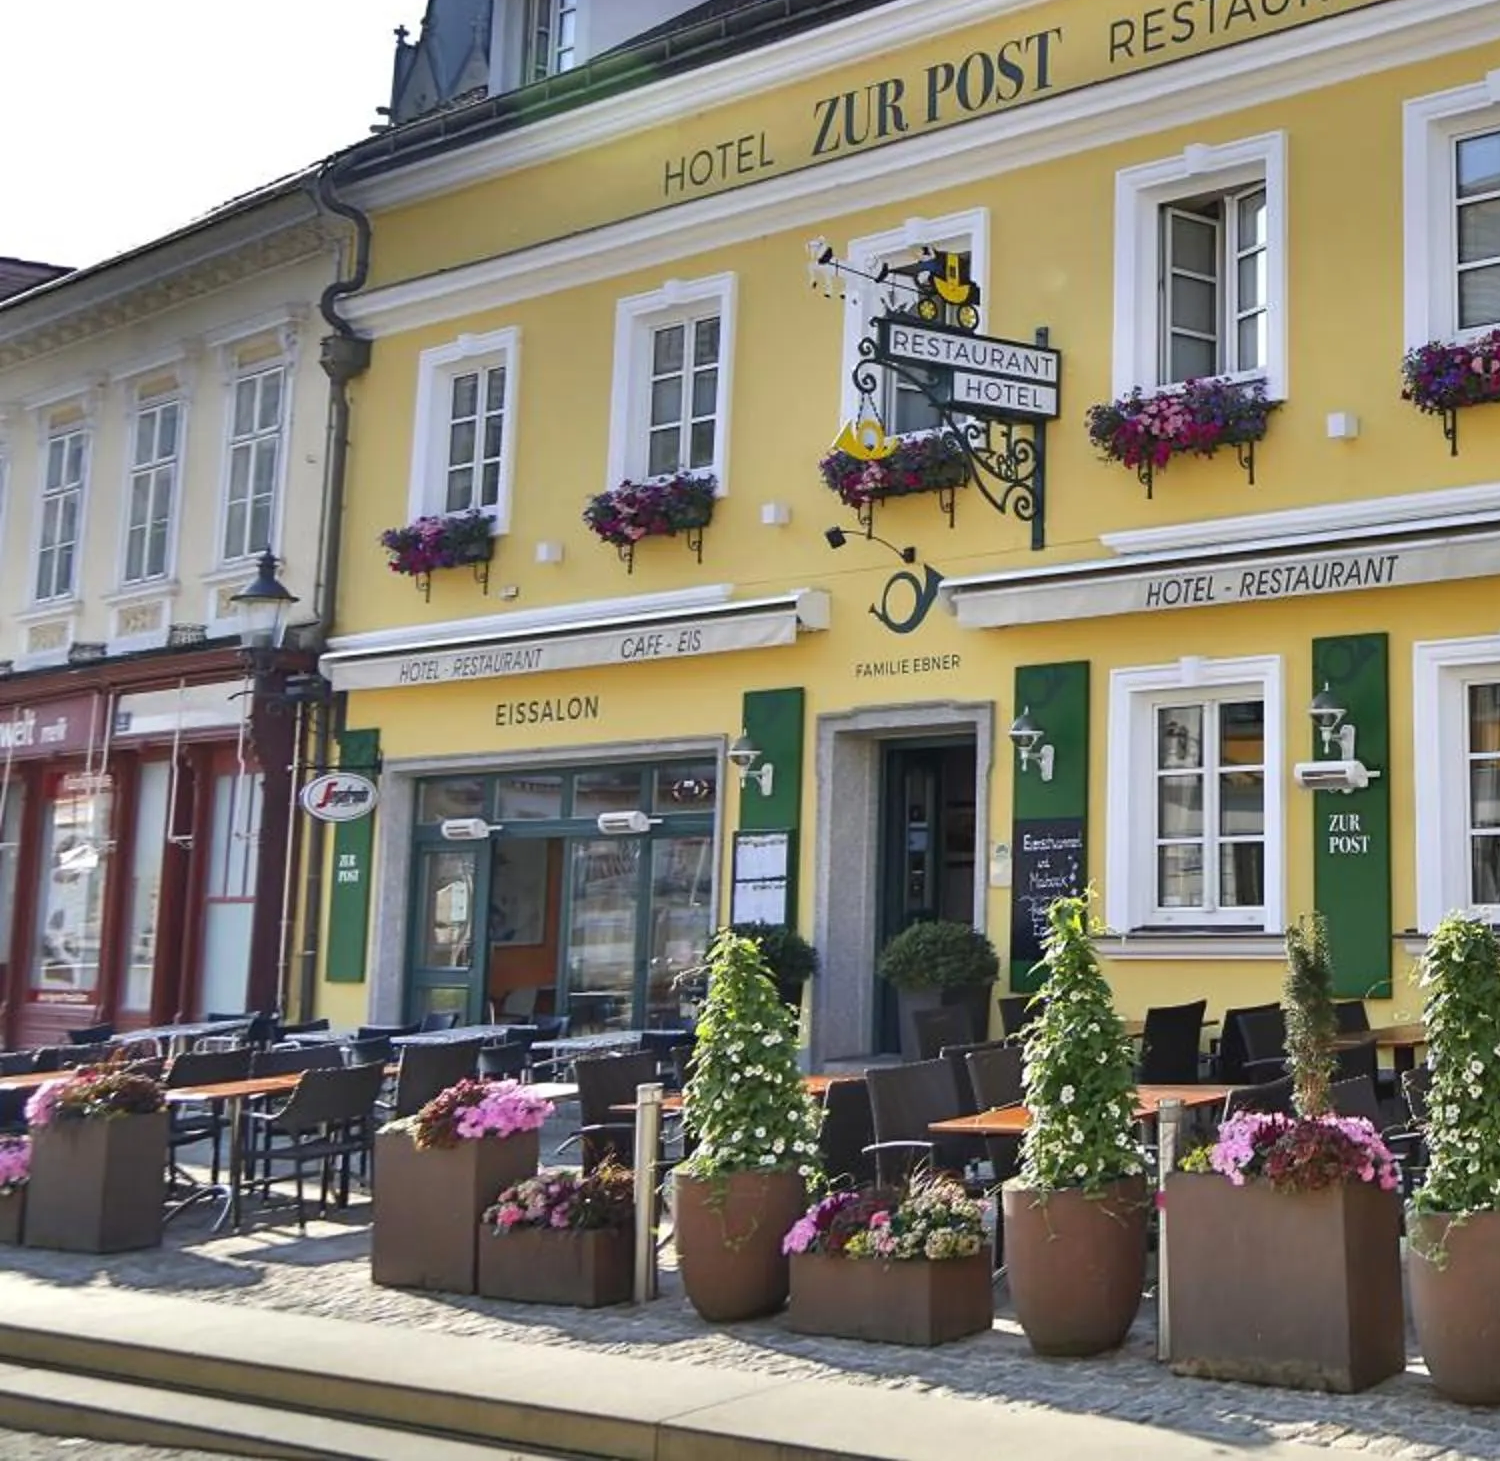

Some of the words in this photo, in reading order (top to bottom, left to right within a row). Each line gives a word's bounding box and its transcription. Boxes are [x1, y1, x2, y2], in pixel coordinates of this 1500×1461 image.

[663, 131, 774, 196] HOTEL
[811, 77, 909, 157] ZUR
[925, 27, 1063, 122] POST
[893, 330, 1054, 377] RESTAURANT
[966, 378, 1043, 409] HOTEL
[1146, 575, 1216, 607] HOTEL
[1239, 554, 1400, 597] RESTAURANT
[621, 633, 664, 659] CAFE
[677, 630, 703, 652] EIS
[400, 660, 439, 683] HOTEL
[452, 648, 544, 676] RESTAURANT
[856, 659, 909, 677] FAMILIE
[913, 654, 960, 673] EBNER
[496, 695, 600, 726] EISSALON
[1329, 814, 1361, 832] ZUR
[1329, 835, 1371, 854] POST
